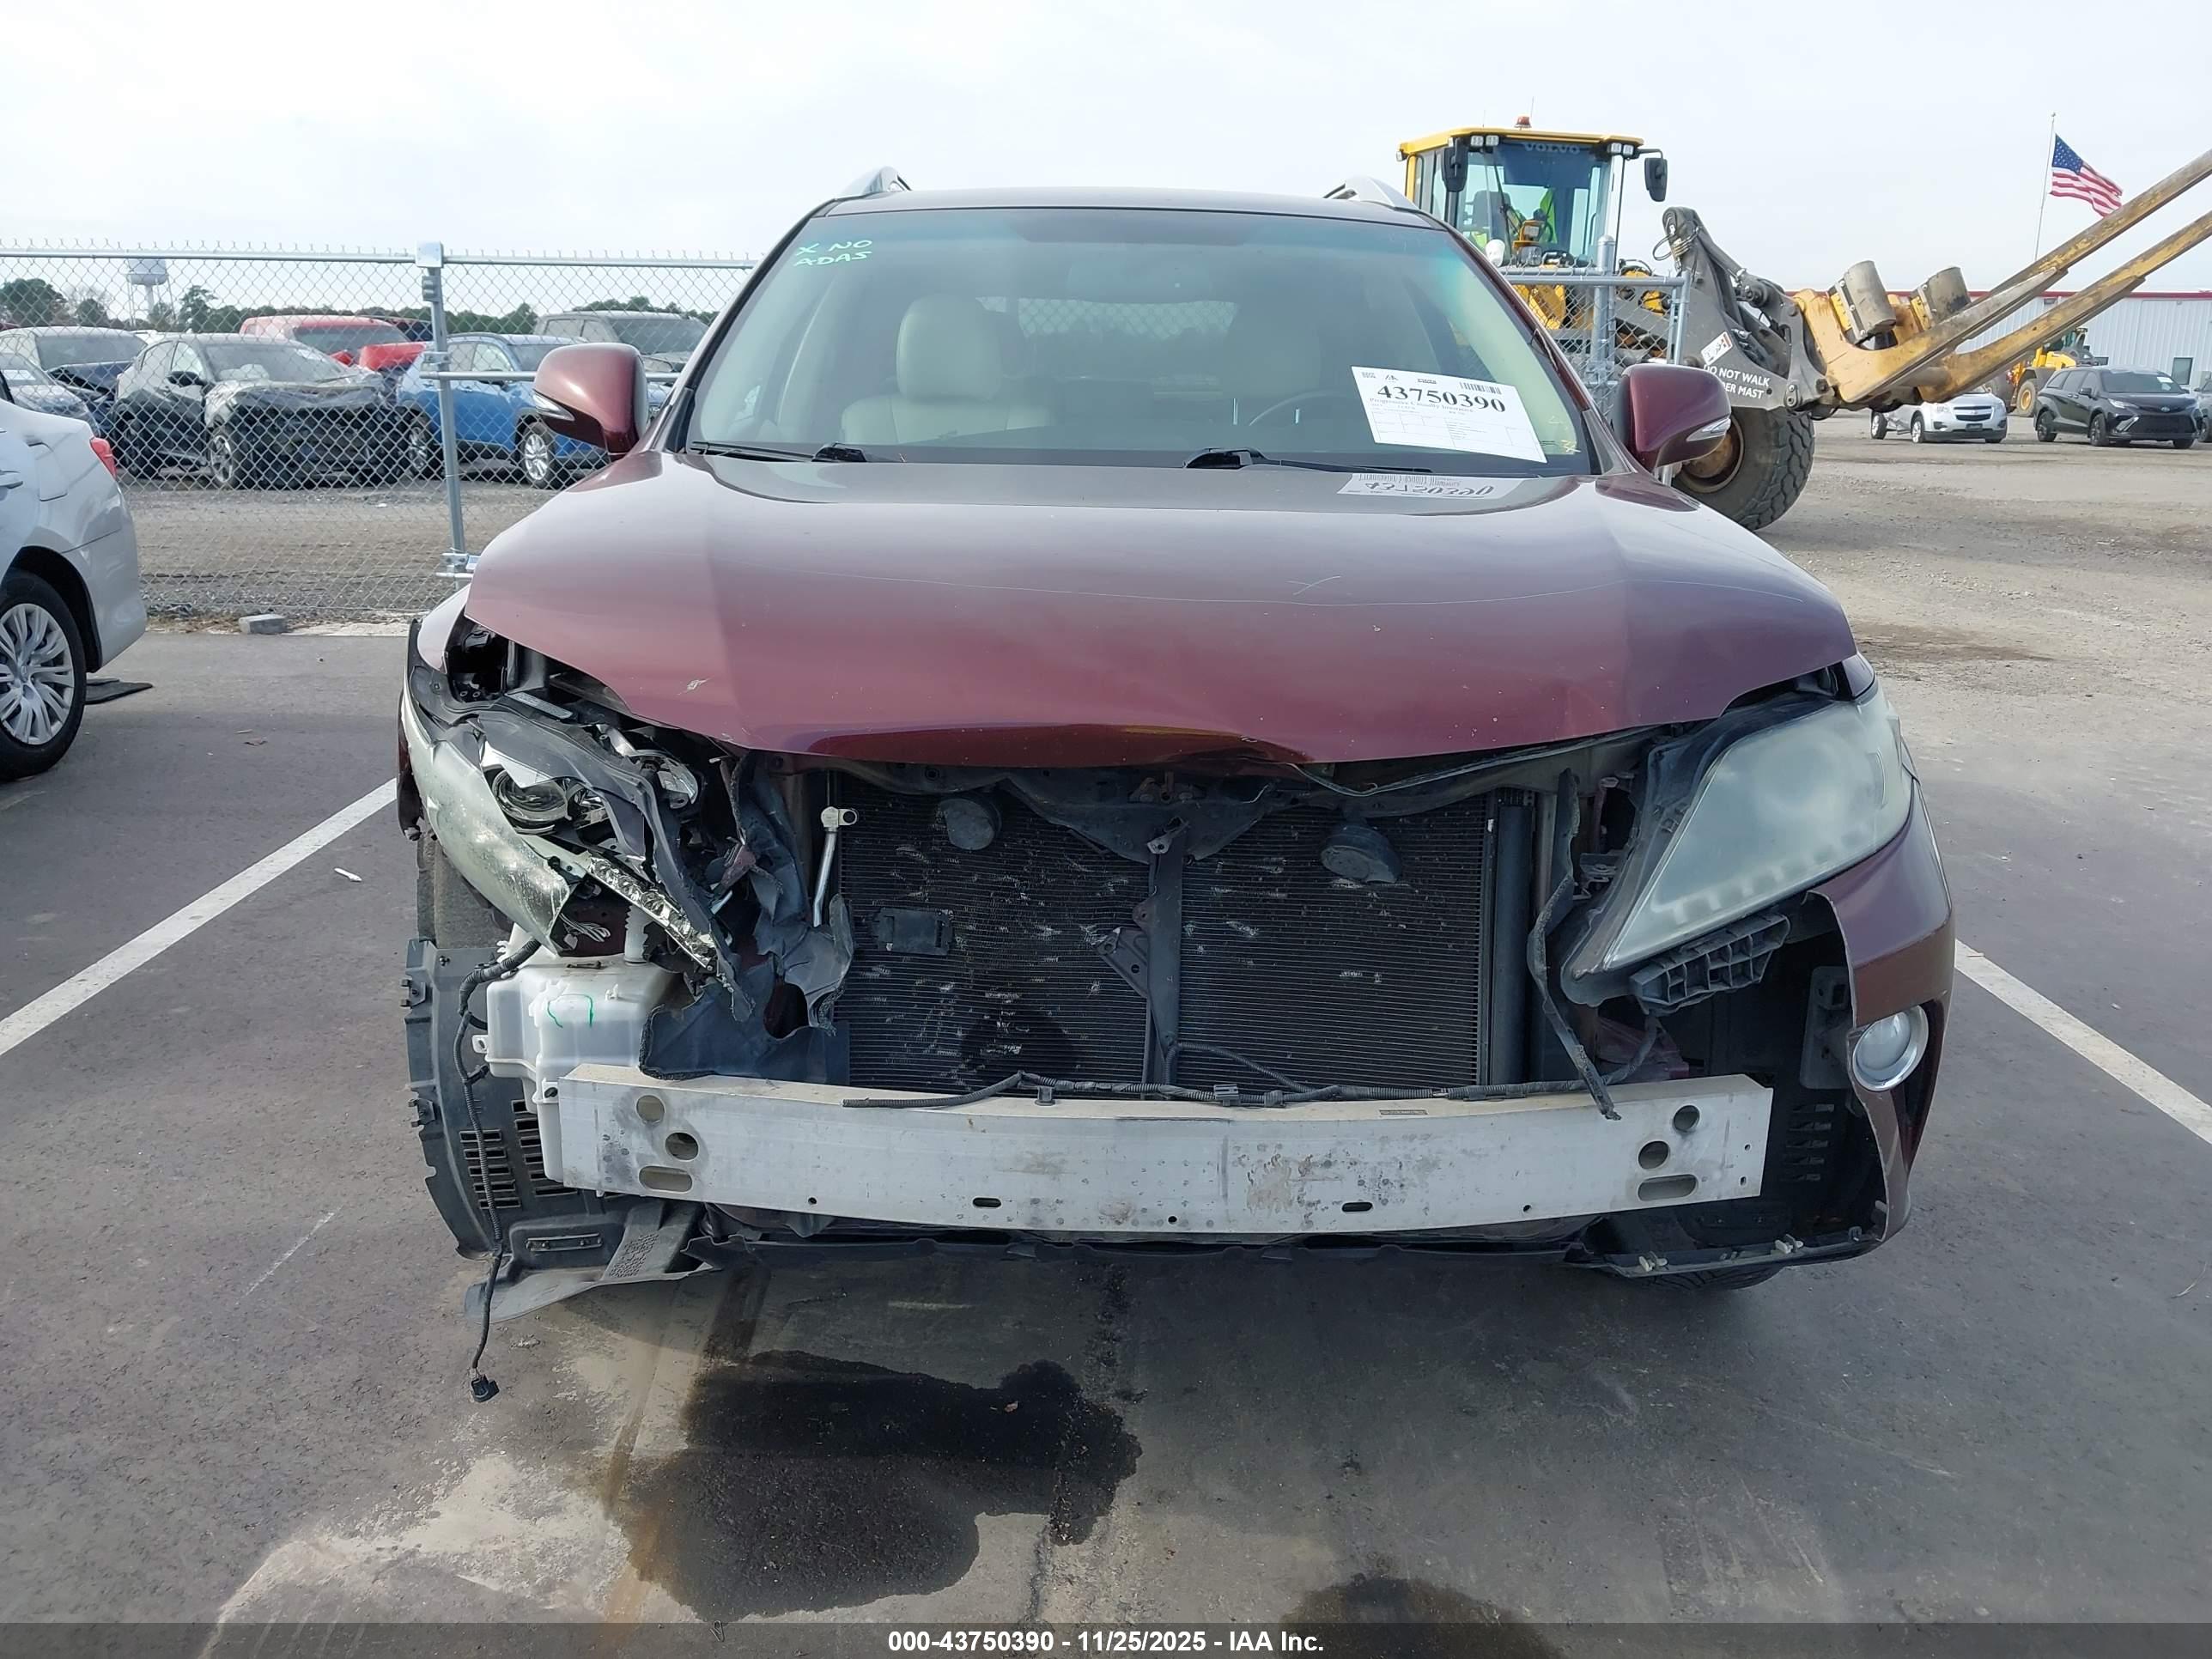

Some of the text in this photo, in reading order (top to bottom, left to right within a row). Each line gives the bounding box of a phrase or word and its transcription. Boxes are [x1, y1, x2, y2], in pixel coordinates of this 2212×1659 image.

[1522, 142, 1581, 155] VOLVO
[828, 240, 873, 252] NO
[793, 251, 873, 267] ADAS
[1718, 368, 1741, 380] NOT
[1742, 373, 1770, 386] WALK
[1377, 385, 1506, 413] 43750390
[1737, 386, 1765, 399] MAST
